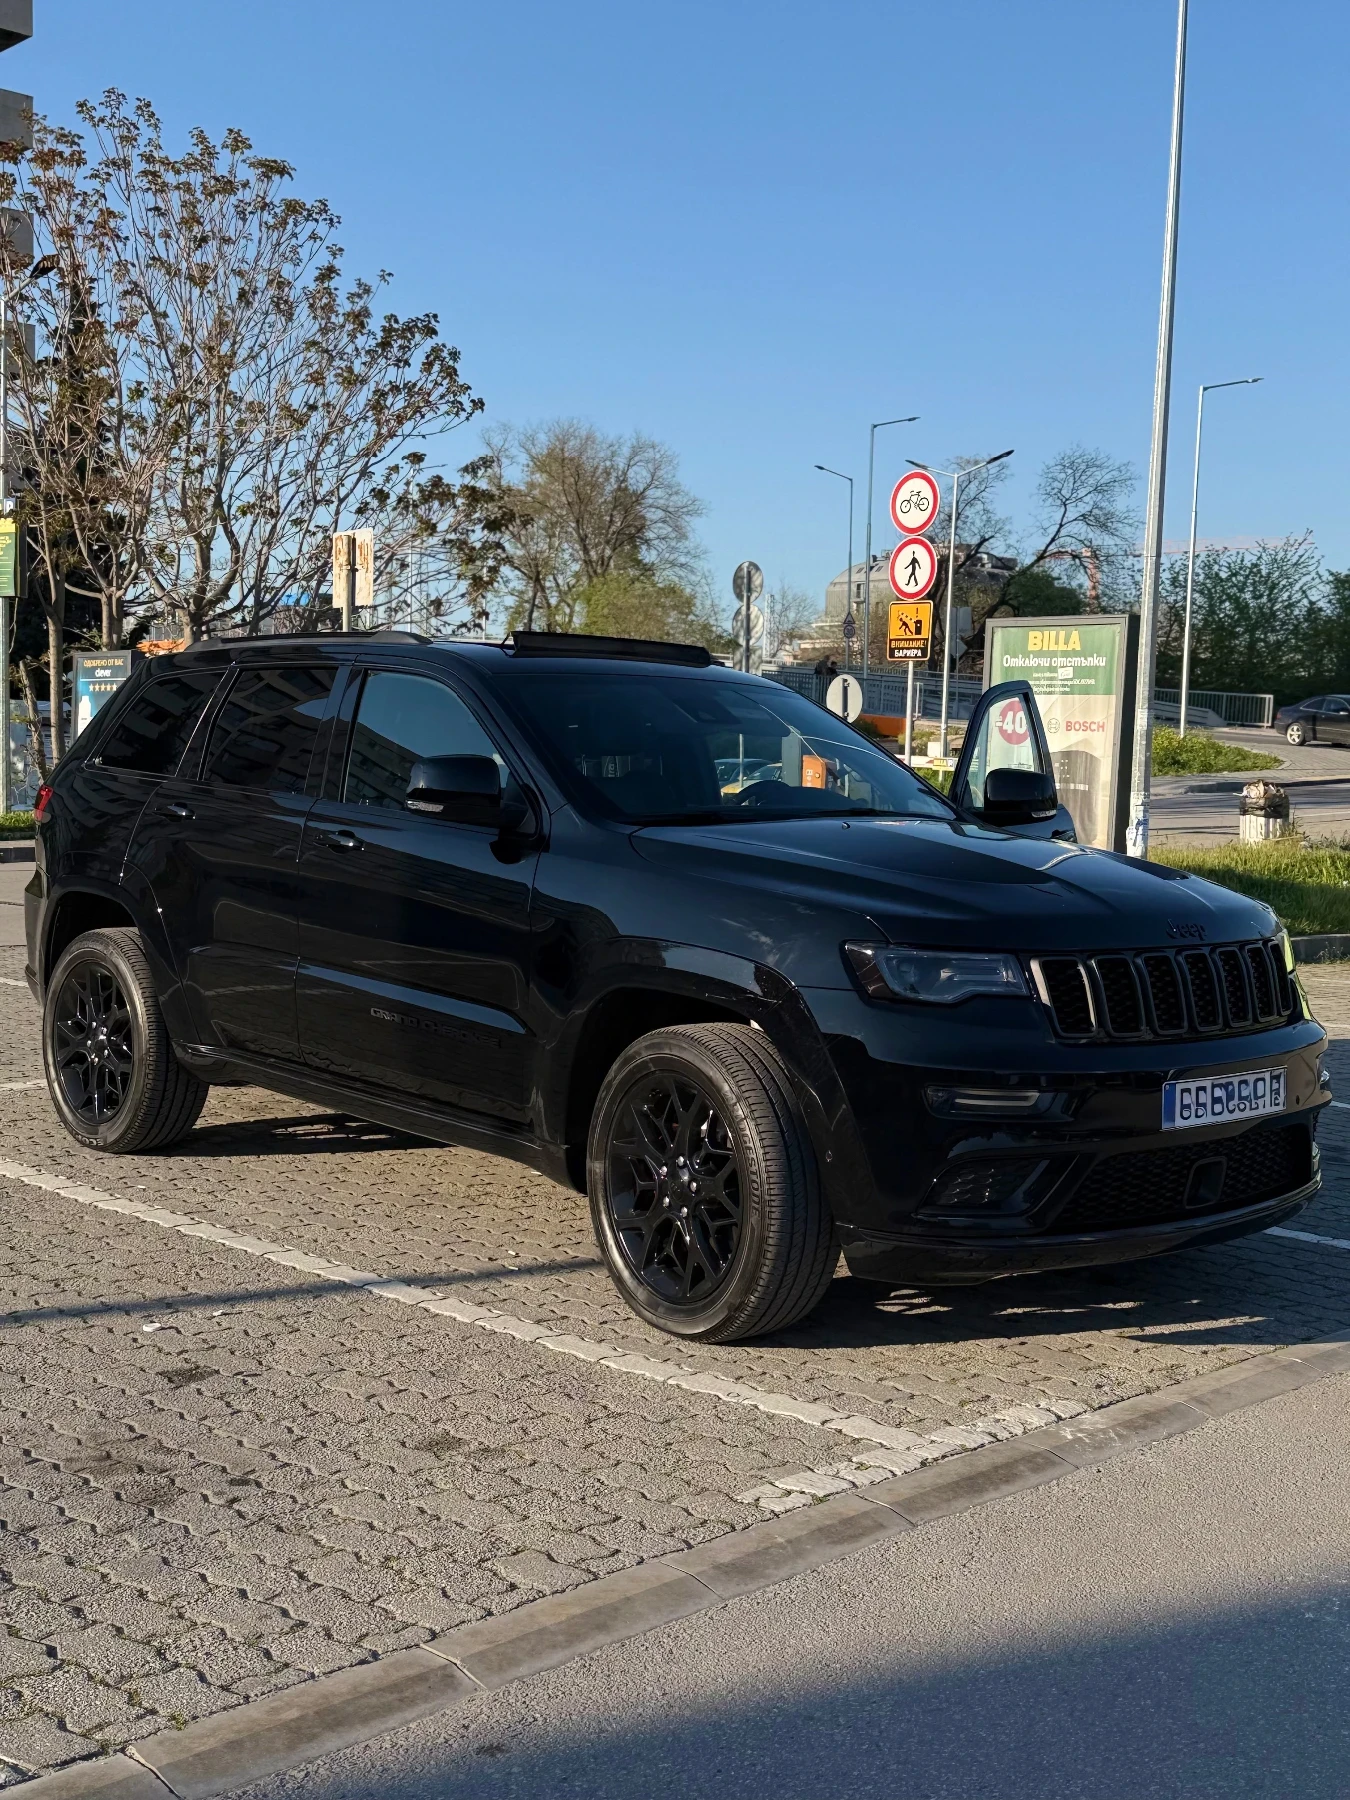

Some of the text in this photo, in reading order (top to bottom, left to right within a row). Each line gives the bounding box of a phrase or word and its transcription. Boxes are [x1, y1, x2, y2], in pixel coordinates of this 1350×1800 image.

[1028, 630, 1081, 651] BILLA
[1003, 653, 1106, 668] Отключи отстъпки
[1065, 720, 1106, 733] BOSCH
[1166, 919, 1206, 941] Jeep
[370, 1007, 420, 1028] GRAND
